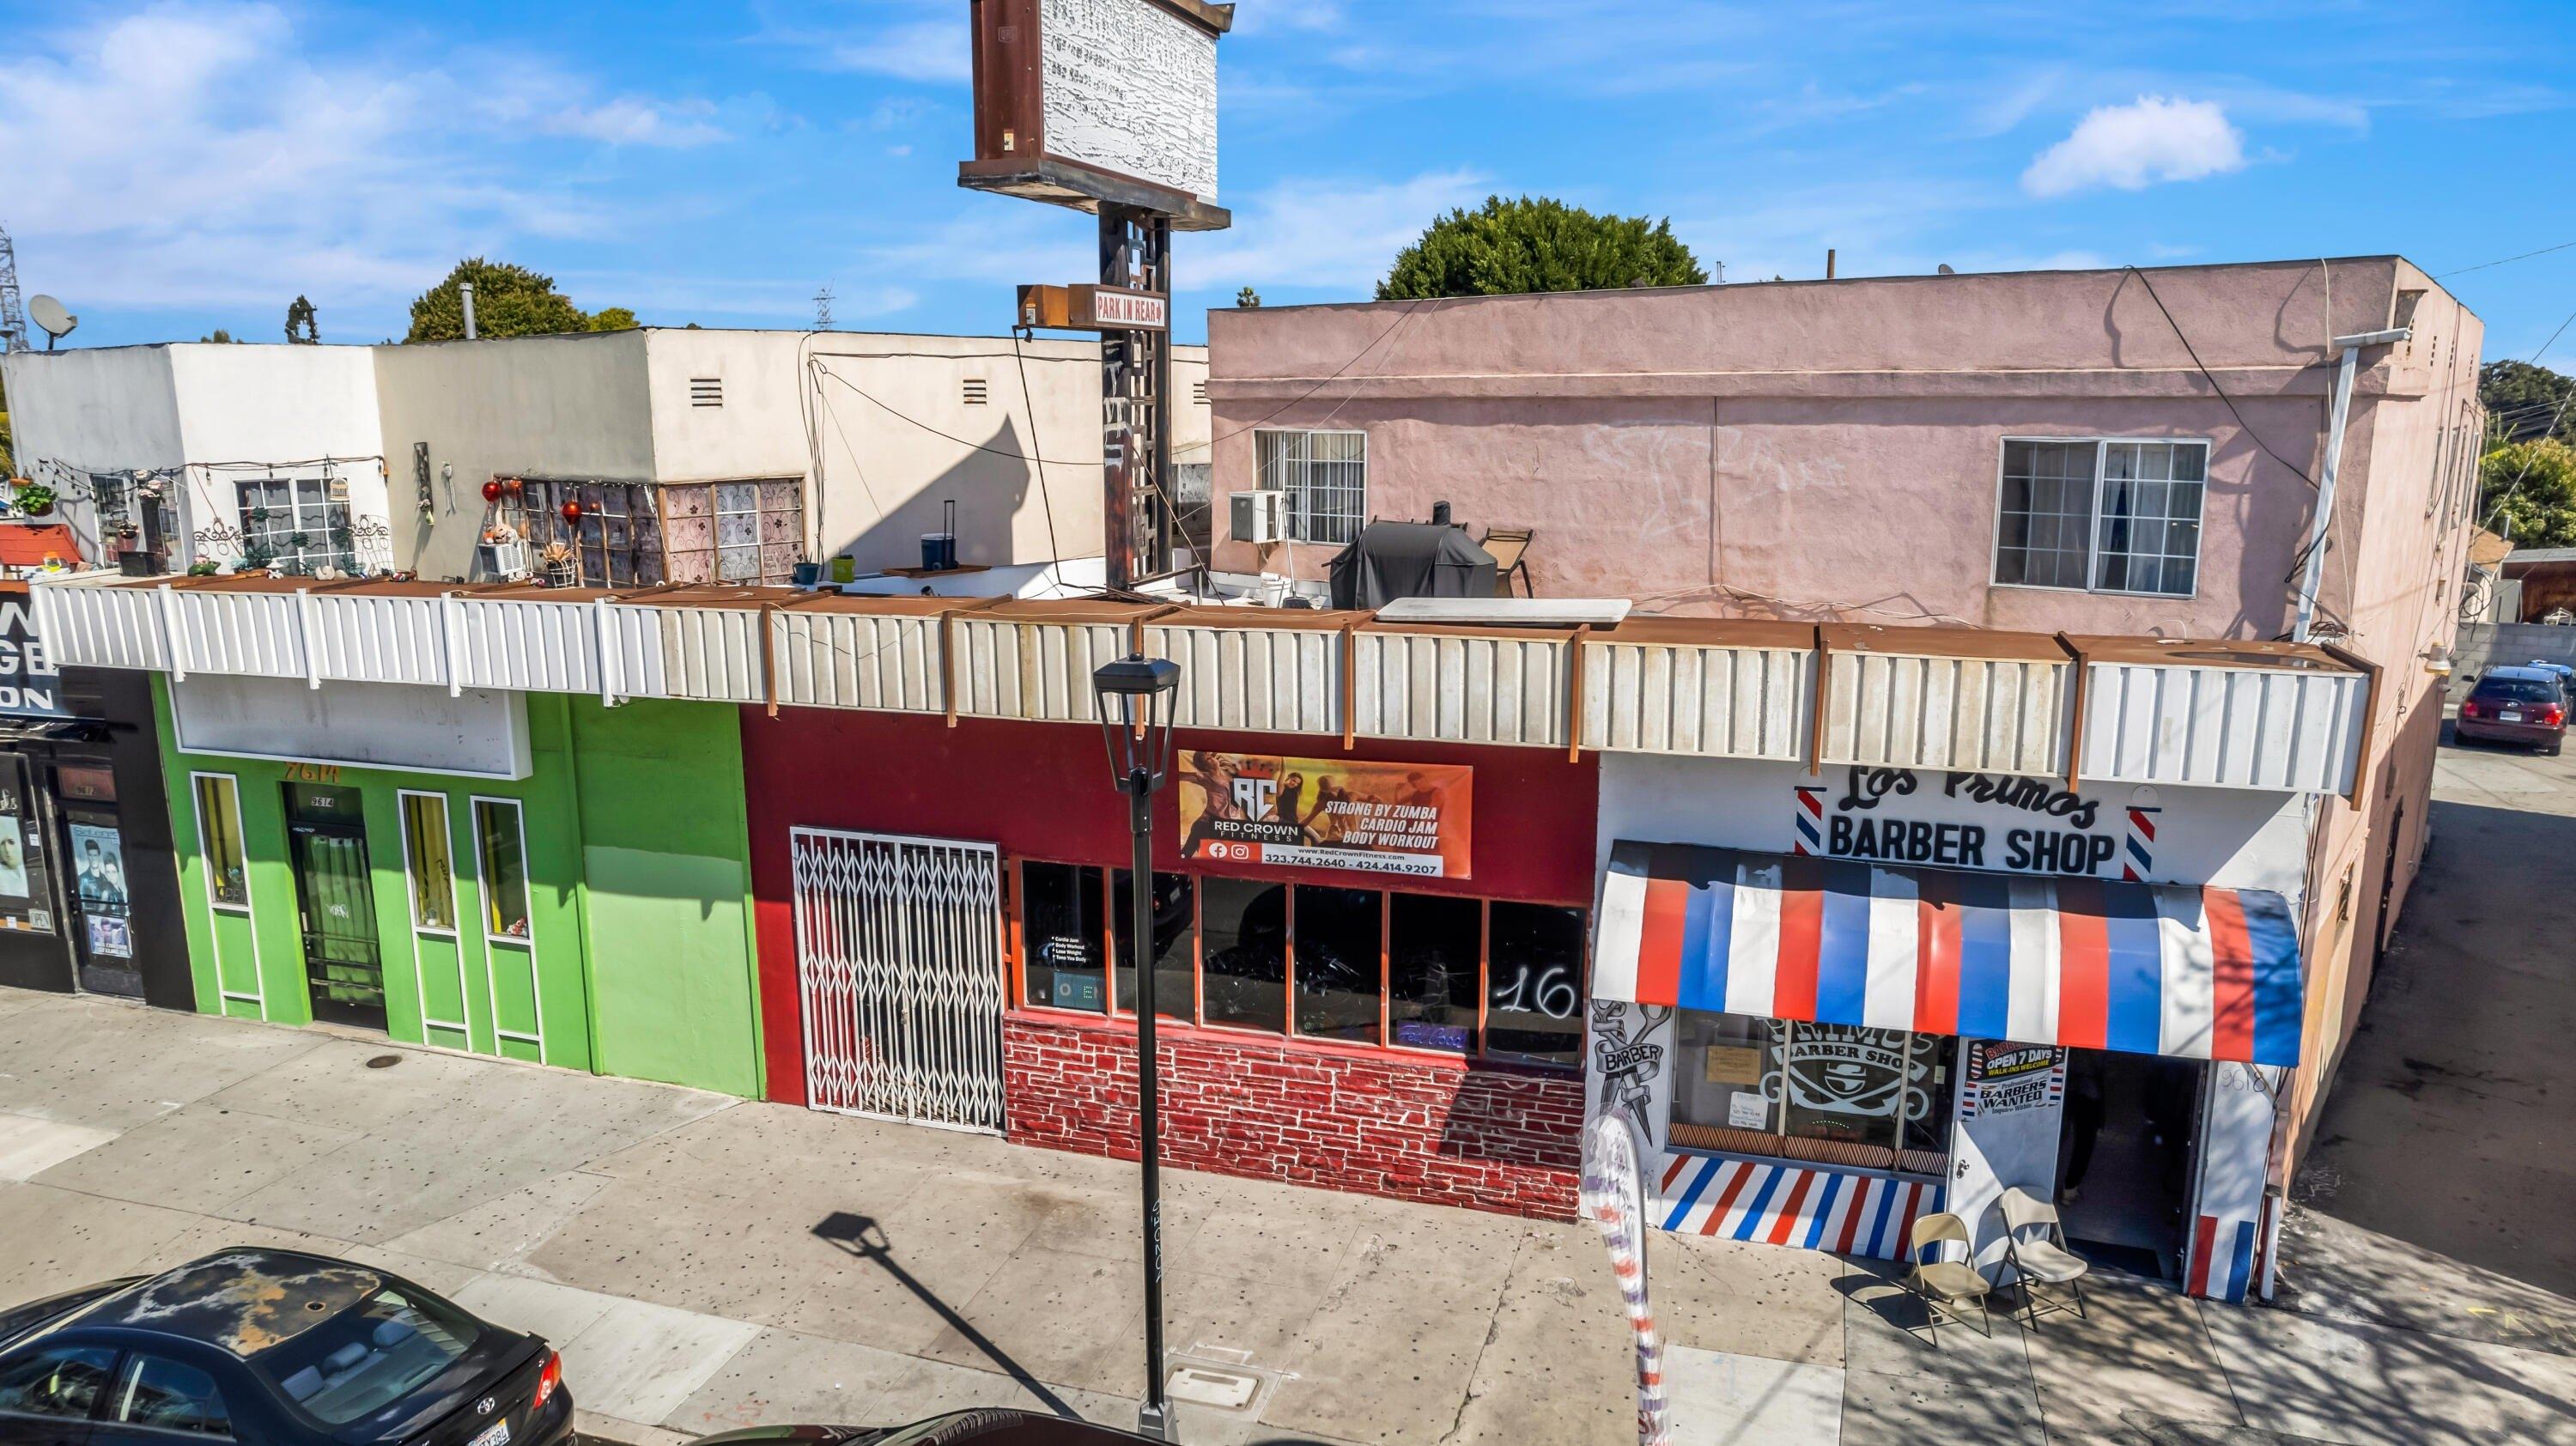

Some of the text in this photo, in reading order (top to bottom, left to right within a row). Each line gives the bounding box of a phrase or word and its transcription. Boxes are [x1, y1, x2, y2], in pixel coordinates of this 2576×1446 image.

[1097, 296, 1156, 322] PARK IN REAR
[284, 762, 341, 783] 9614
[1838, 765, 1917, 811] Los
[312, 797, 334, 806] 9614
[1324, 800, 1437, 820] STRONG BY ZUMBA
[1214, 821, 1298, 836] RED CROWN
[1220, 830, 1292, 842] FITNESS
[1360, 817, 1438, 835] CARDIO JAM
[1343, 830, 1439, 849] BODY WORKOUT
[1829, 815, 2116, 875] BARBER SHOP
[1265, 854, 1346, 867] 323.744.2640
[1356, 860, 1437, 875] 424.414.9207
[1297, 848, 1406, 861] www.RedCrownFitness.com
[1496, 966, 1576, 1020] 16
[1604, 1045, 1660, 1071] BARBER
[1987, 1049, 2052, 1070] OPEN 7 DAYS
[1988, 1059, 2050, 1076] WALK-INS WELCOME
[1980, 1079, 2047, 1099] BARBERS
[2222, 1069, 2267, 1092] 9618
[1984, 1090, 2043, 1108] WANTED
